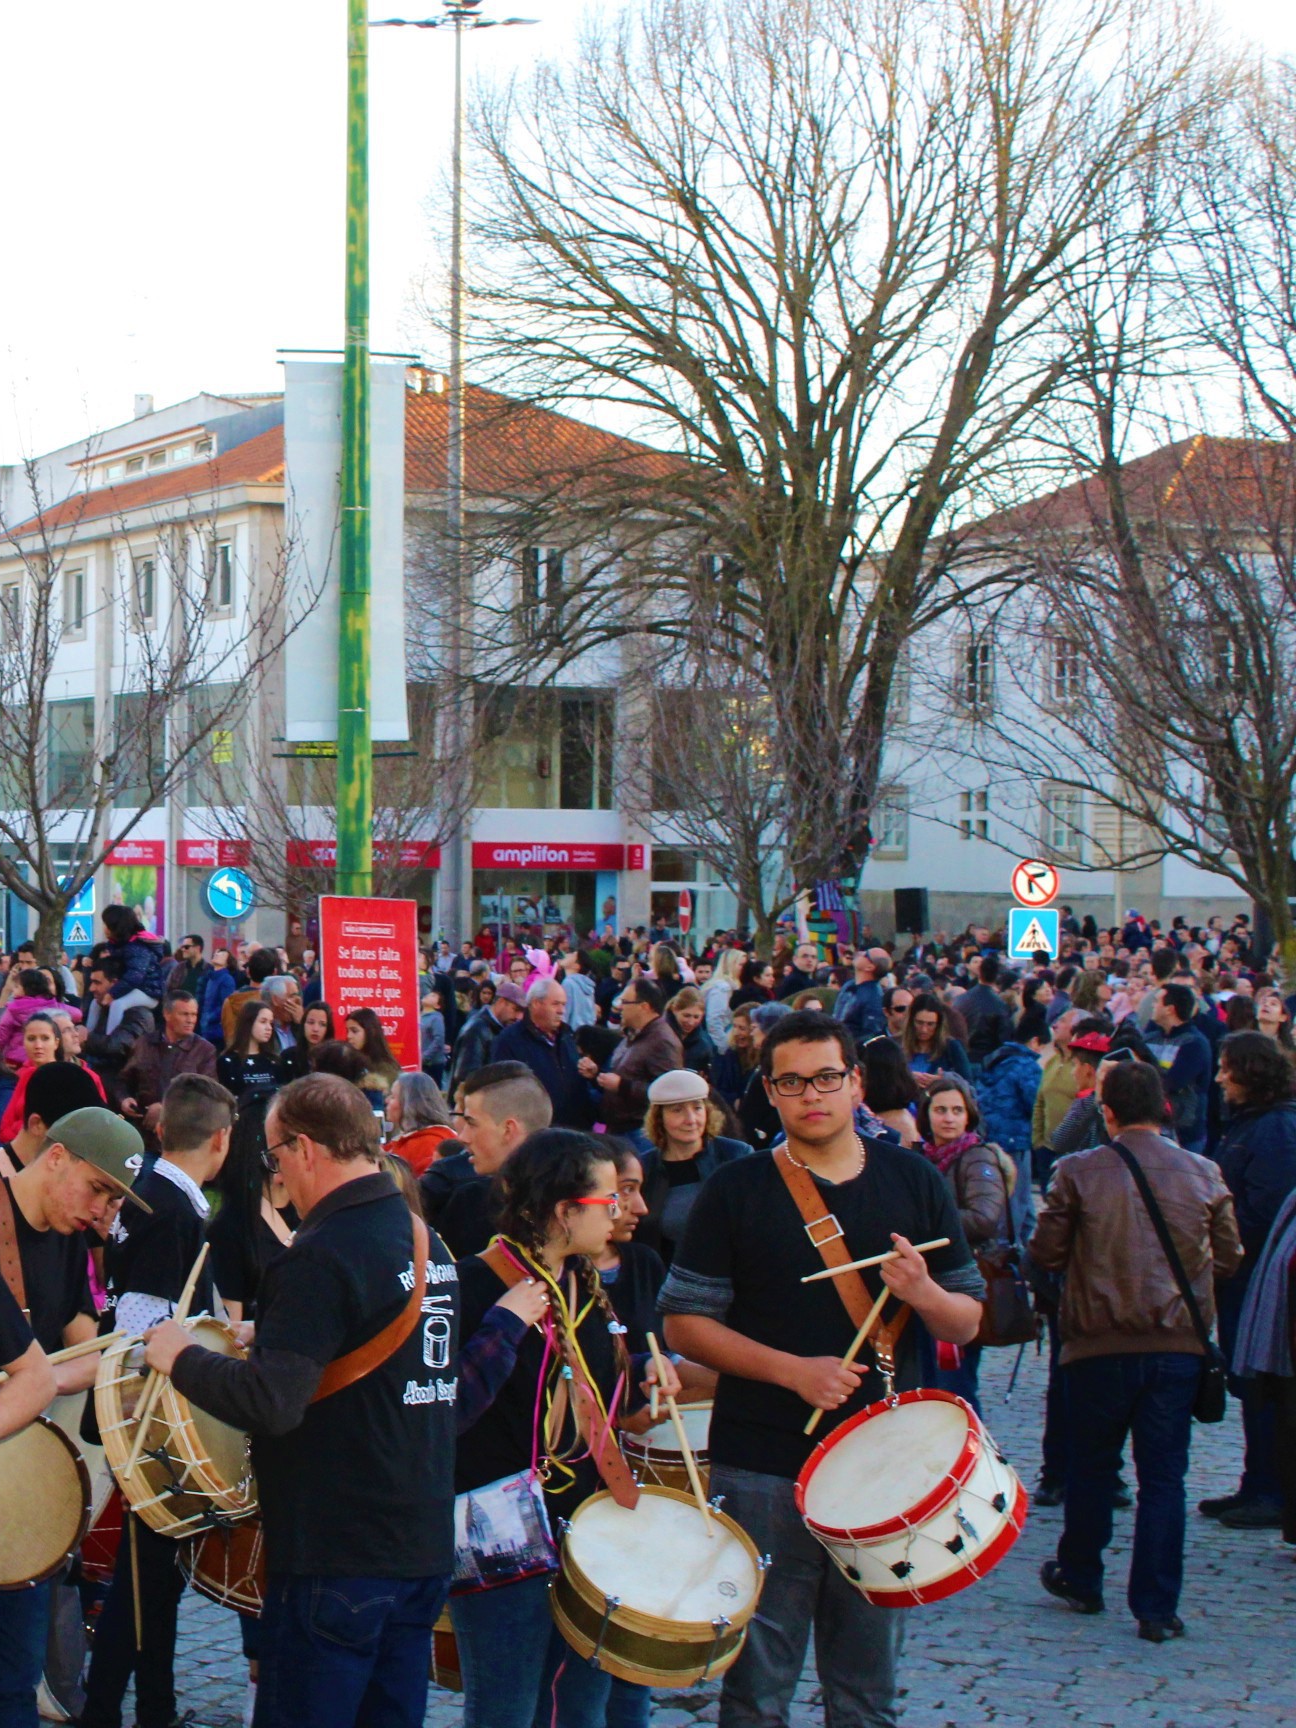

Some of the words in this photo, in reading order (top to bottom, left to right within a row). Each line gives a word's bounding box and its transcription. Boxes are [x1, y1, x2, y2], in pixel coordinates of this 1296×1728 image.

[492, 845, 569, 867] amplifon
[338, 946, 350, 959] Se
[352, 946, 377, 960] fazes
[378, 947, 401, 961] falta
[338, 965, 364, 979] todos
[366, 969, 377, 979] os
[379, 966, 402, 983] dias,
[340, 987, 374, 1001] porque
[375, 984, 382, 998] é
[384, 988, 401, 1001] que
[338, 1006, 346, 1016] o
